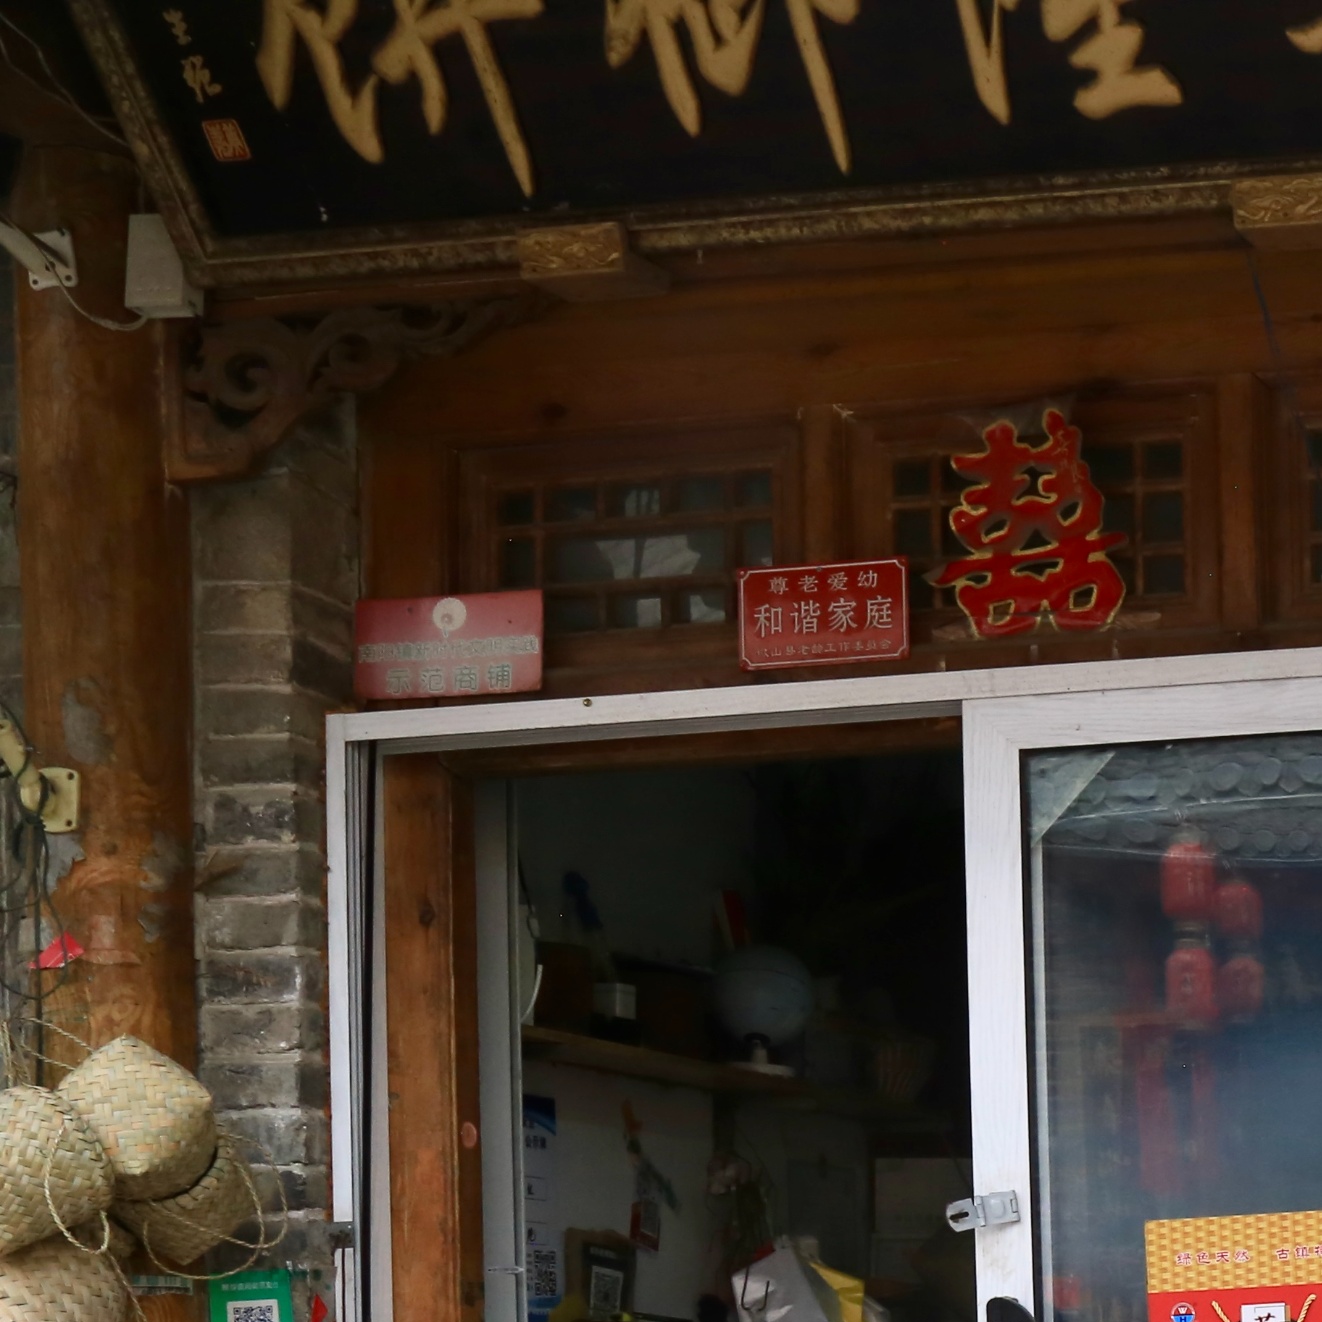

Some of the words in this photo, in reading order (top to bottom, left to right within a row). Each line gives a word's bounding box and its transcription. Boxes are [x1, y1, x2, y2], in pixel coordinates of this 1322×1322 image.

[768, 569, 878, 595] 尊老爱幼
[754, 594, 893, 638] 和谐家庭
[386, 663, 511, 694] 示范商铺
[1176, 1249, 1250, 1266] 绿色天然
